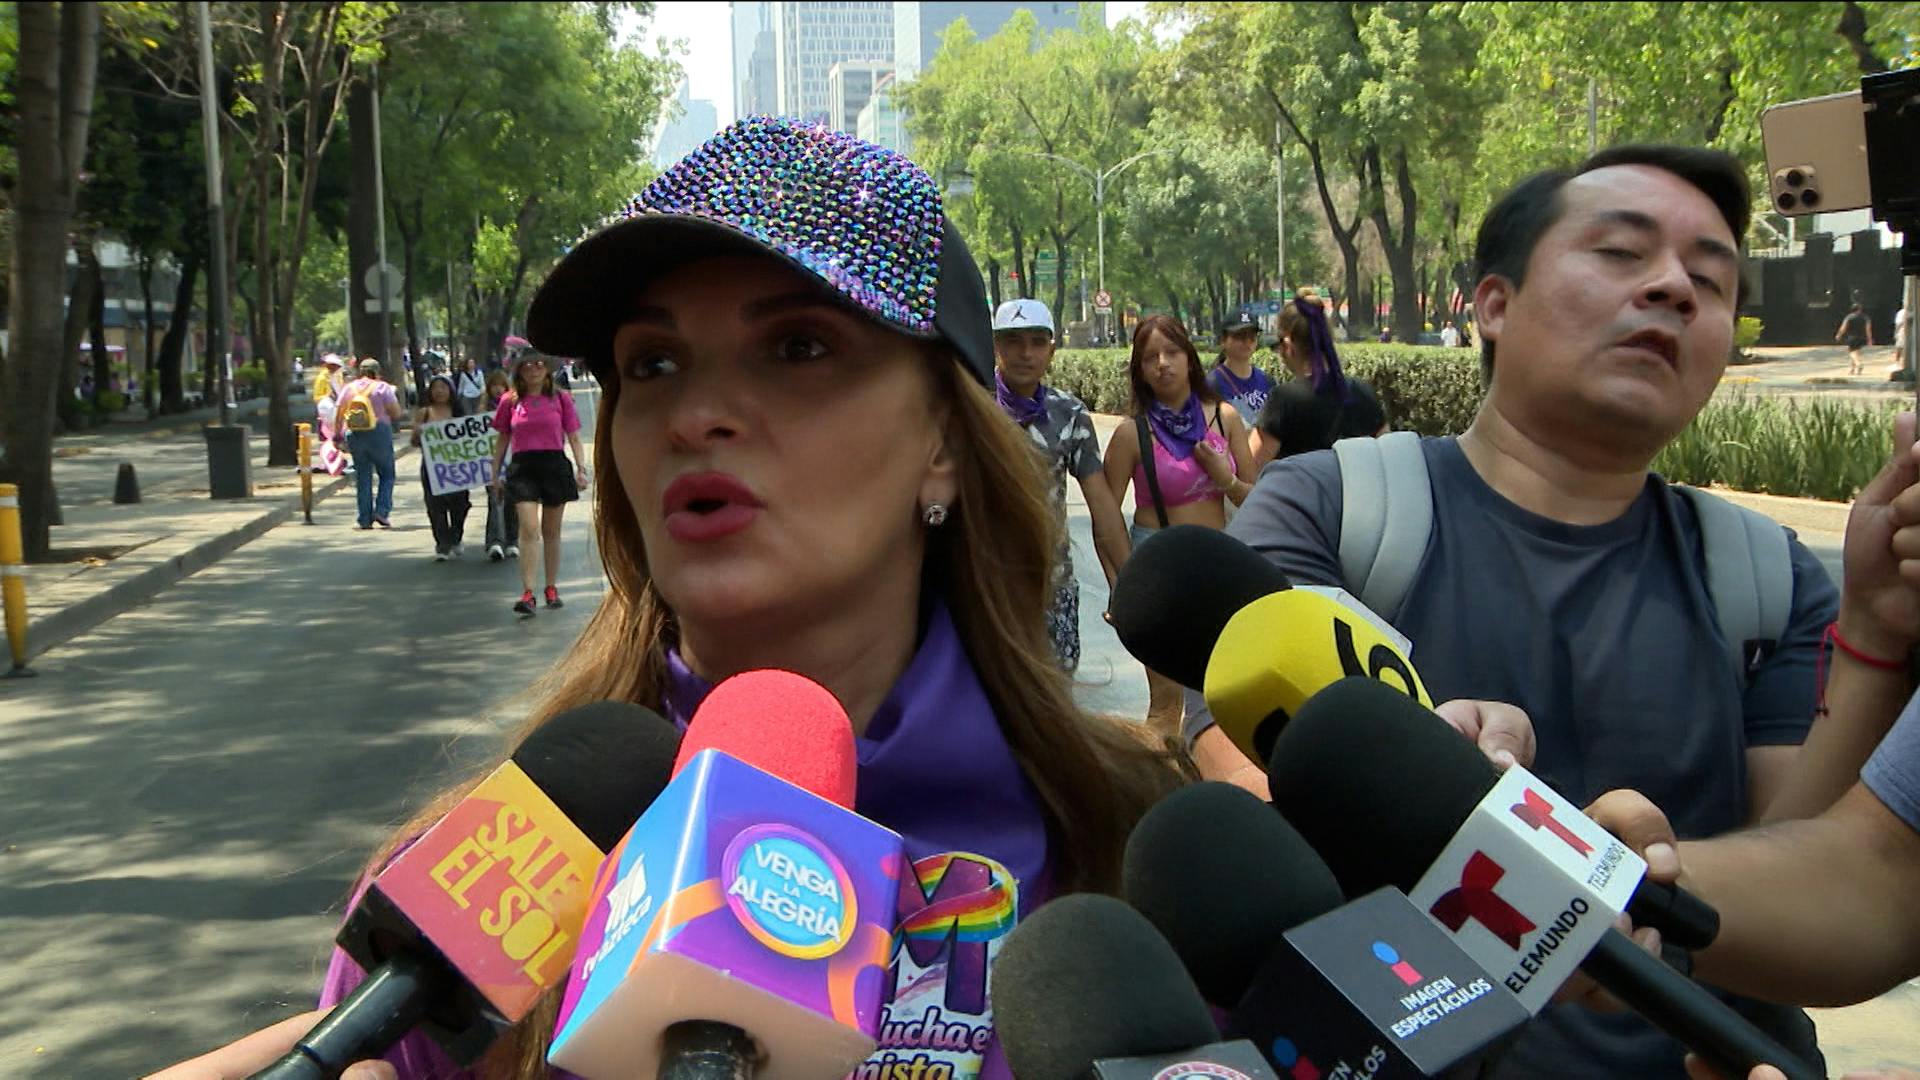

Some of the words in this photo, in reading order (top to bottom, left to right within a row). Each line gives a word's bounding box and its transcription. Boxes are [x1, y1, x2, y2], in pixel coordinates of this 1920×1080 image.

[424, 424, 444, 441] MI
[444, 414, 494, 440] CUERP
[434, 458, 496, 489] RESPE
[477, 803, 583, 914] SALE
[754, 843, 839, 904] VENGA
[429, 836, 496, 911] EL
[480, 886, 569, 987] SOL
[727, 874, 841, 943] ALEGRÍA
[783, 881, 801, 899] LA
[1503, 897, 1590, 995] ELEMUNDO
[1390, 977, 1493, 1038] ESPECTÁCULOS
[1400, 975, 1457, 1012] IMAGEN
[853, 1053, 955, 1080] nista
